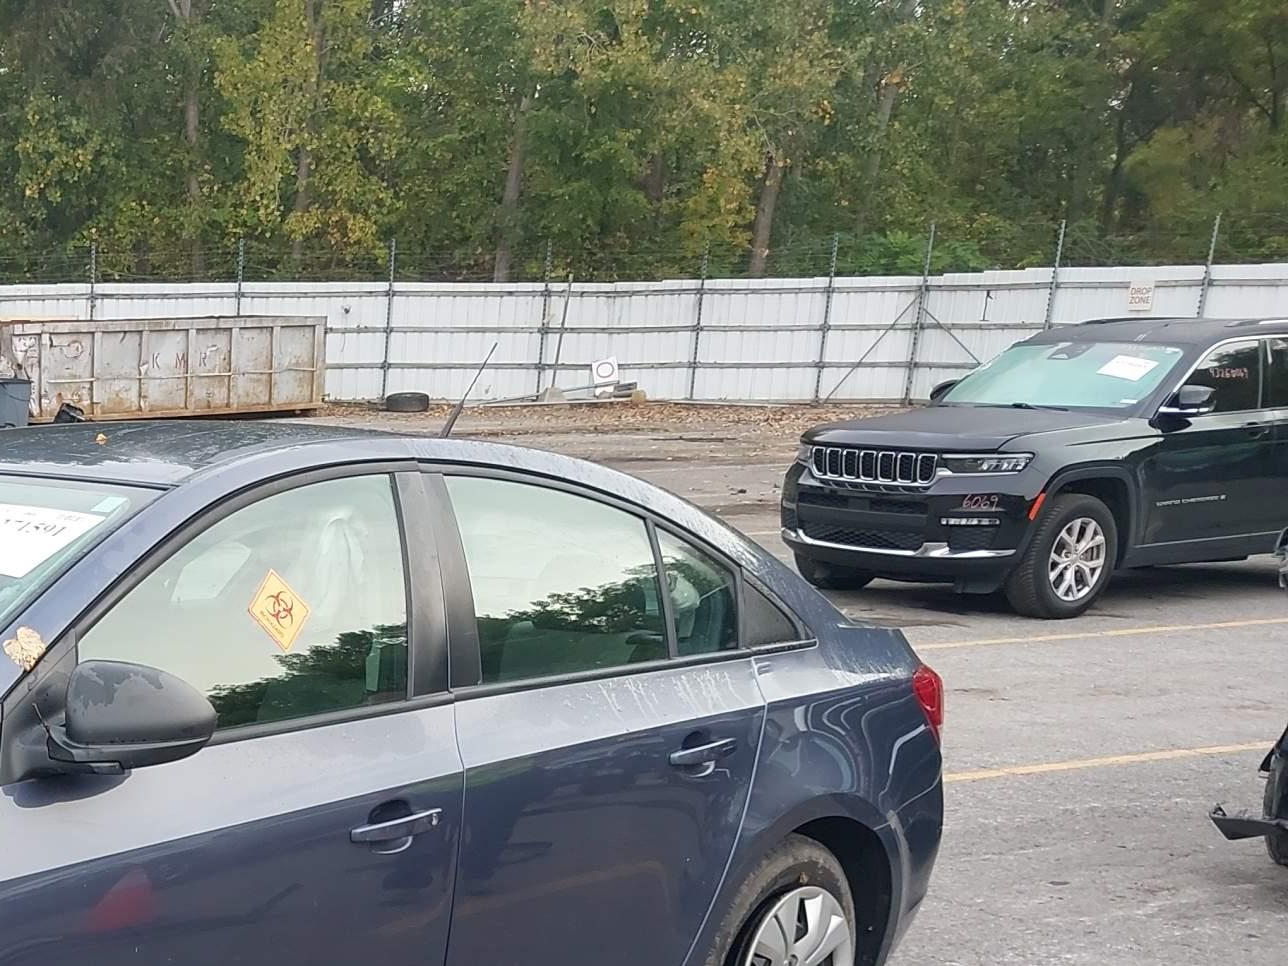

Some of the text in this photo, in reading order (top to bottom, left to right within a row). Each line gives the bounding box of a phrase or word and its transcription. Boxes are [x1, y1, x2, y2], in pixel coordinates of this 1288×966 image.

[1130, 287, 1153, 295] DROP
[1128, 296, 1151, 304] ZONE
[962, 493, 999, 511] 6069
